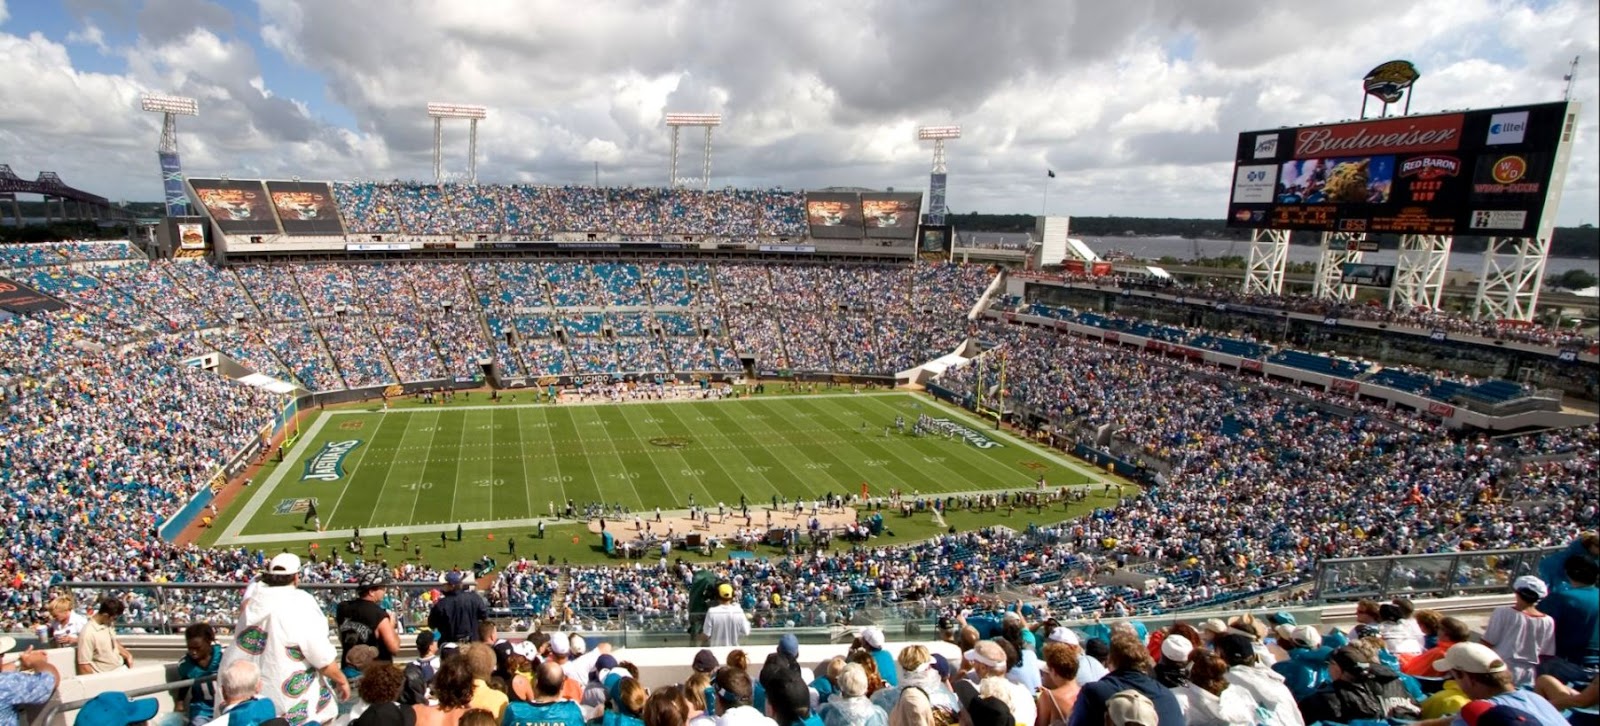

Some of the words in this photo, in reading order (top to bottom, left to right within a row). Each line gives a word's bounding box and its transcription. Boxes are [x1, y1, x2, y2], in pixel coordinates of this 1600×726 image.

[1296, 124, 1457, 155] Budweiser
[1403, 160, 1422, 172] RED
[1422, 157, 1456, 171] BARON
[569, 375, 609, 384] TOUCHDO
[653, 373, 675, 381] CLUB
[303, 440, 359, 481] JAGUARS
